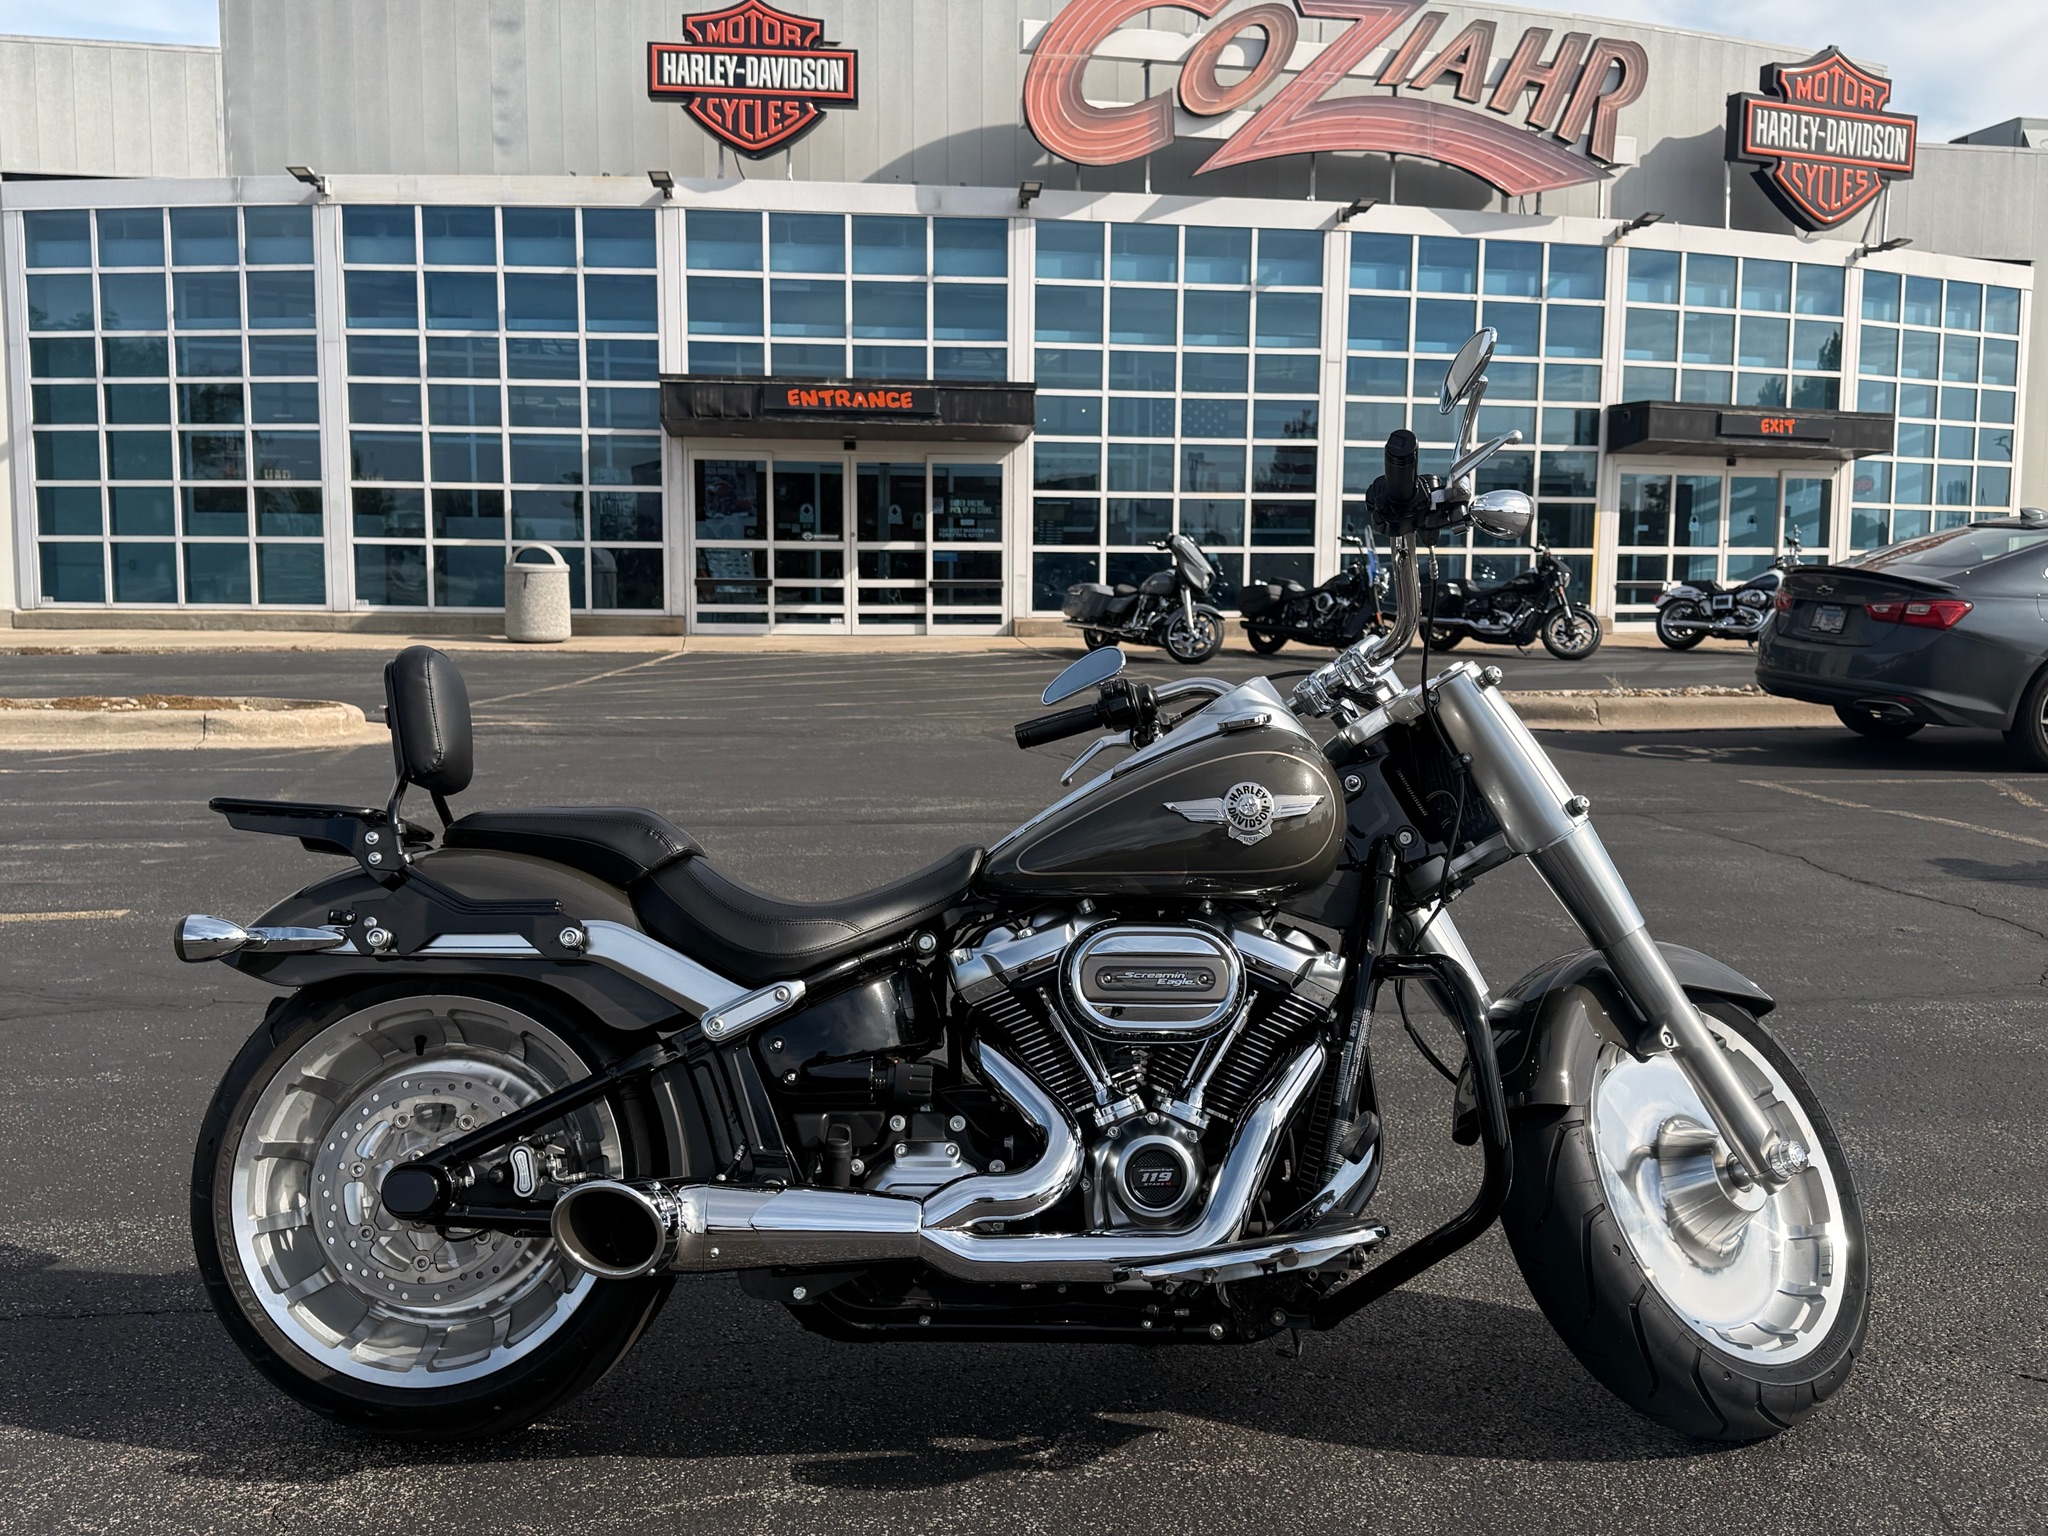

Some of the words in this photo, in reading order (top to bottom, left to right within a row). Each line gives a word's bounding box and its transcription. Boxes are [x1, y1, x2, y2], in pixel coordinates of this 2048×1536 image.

[706, 8, 802, 47] MOTOR
[662, 52, 844, 92] HARLEY-DAVIDSON
[1795, 65, 1875, 110] MOTOR
[706, 97, 800, 141] CYCLES
[1756, 109, 1907, 162] HARLEY-DAVIDSON
[1791, 161, 1869, 212] CYCLES
[787, 388, 913, 409] ENTRANCE
[1229, 785, 1268, 802] HARLEY
[1227, 805, 1271, 829] DAVIDSON
[1156, 977, 1196, 987] Eagle
[1141, 1172, 1173, 1183] 119
